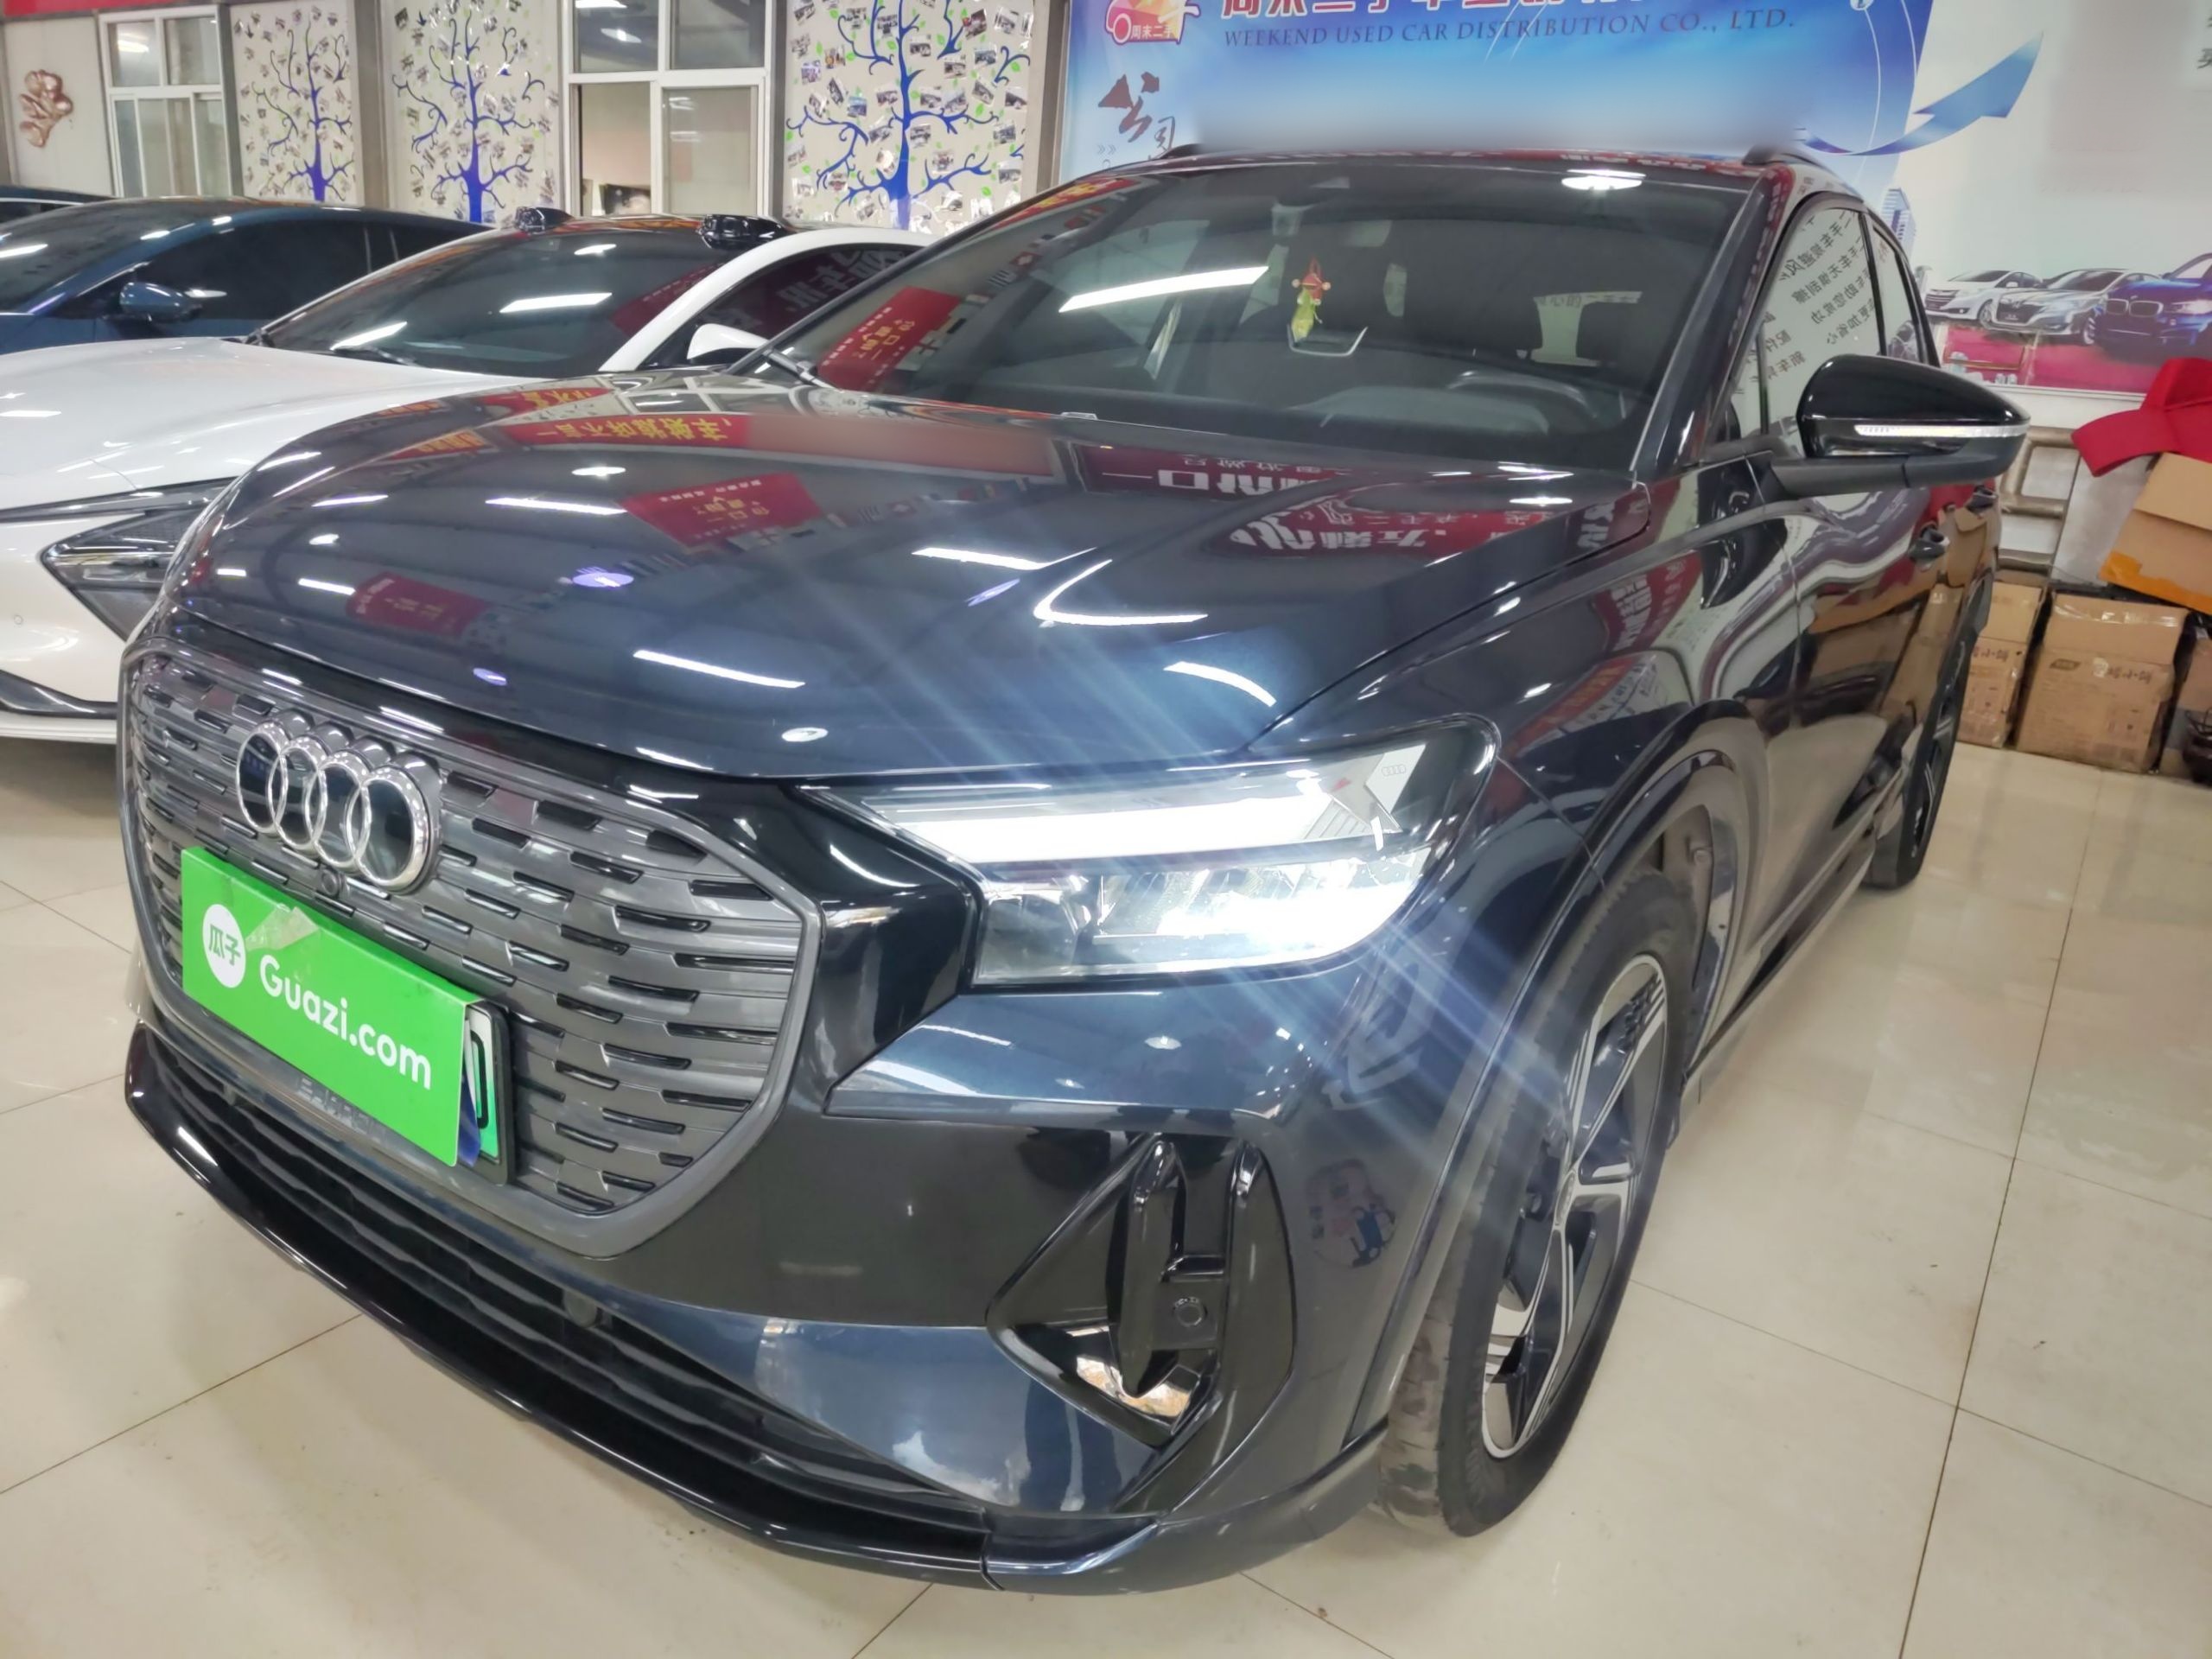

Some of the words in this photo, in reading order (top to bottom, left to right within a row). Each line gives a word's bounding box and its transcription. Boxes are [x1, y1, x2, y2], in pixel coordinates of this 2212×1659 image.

[1225, 28, 1327, 48] WEEKEND
[1336, 25, 1394, 44] USED
[1402, 22, 1448, 42] CAR
[1457, 14, 1649, 41] DISTRIBUTION
[1660, 12, 1717, 34] CO.,
[1730, 8, 1796, 30] LTD.
[209, 924, 242, 967] 瓜子
[259, 954, 431, 1090] Guazi.com
